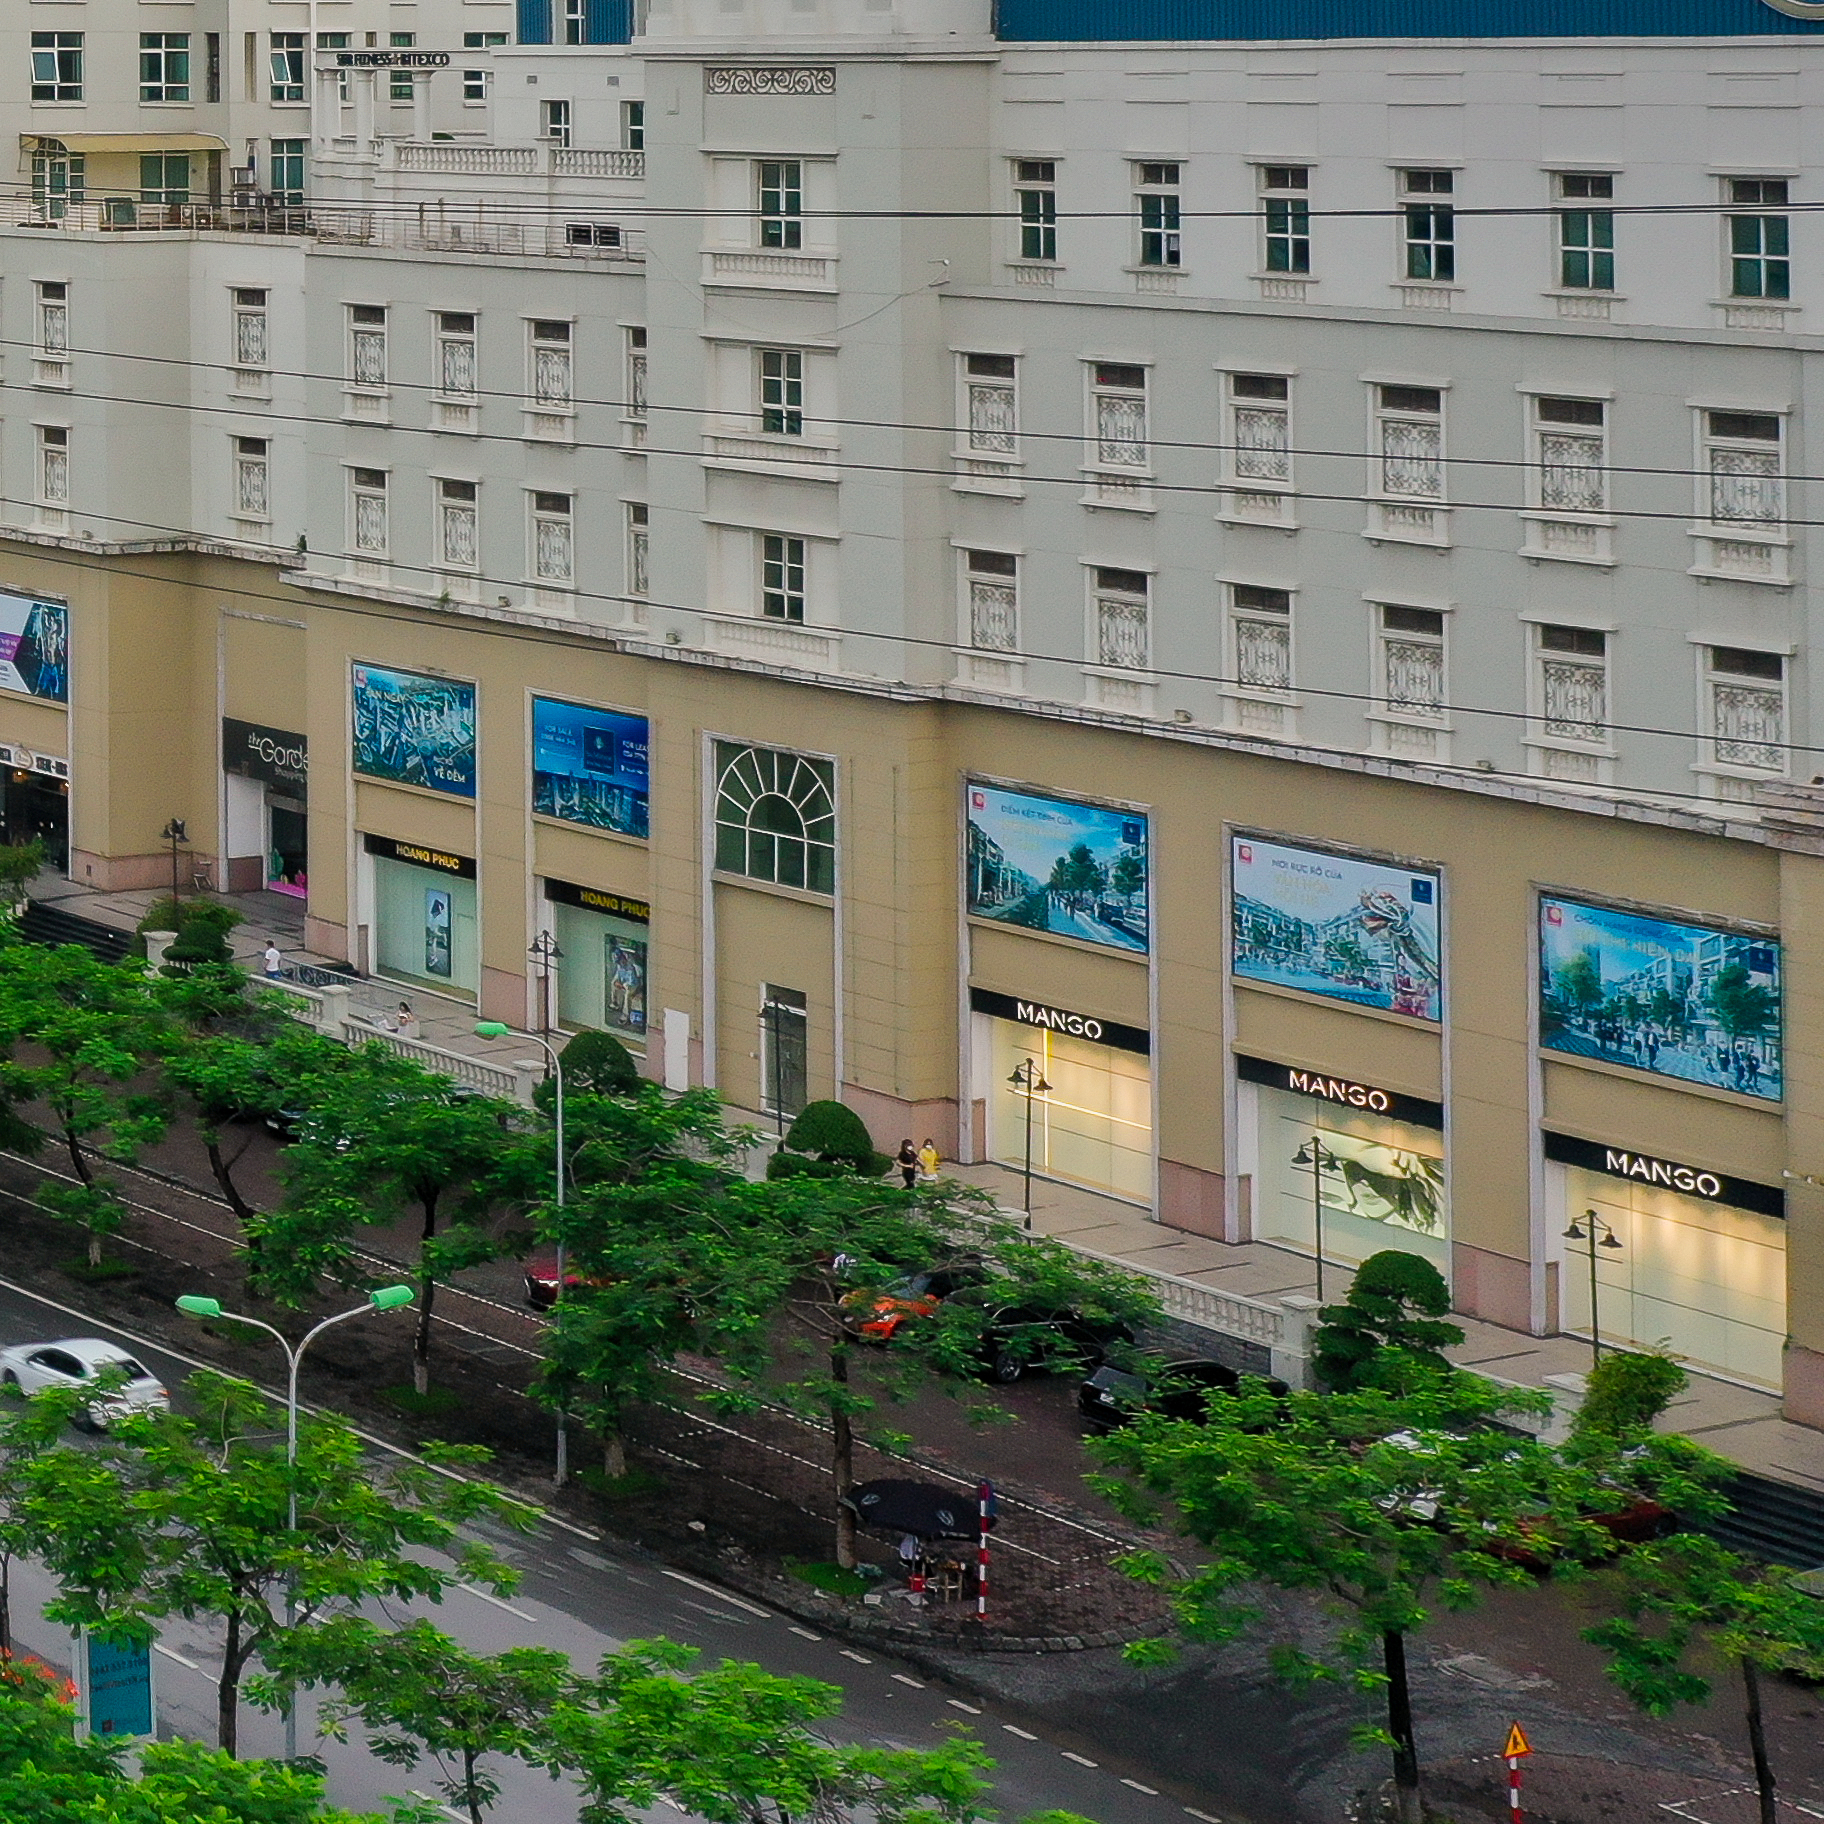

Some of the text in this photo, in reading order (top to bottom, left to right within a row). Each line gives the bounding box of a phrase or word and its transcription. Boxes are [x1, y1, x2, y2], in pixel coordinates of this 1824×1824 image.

[1017, 1001, 1102, 1039] MANGO
[1288, 1068, 1389, 1112] MANGO
[1605, 1148, 1721, 1199] MANGO
